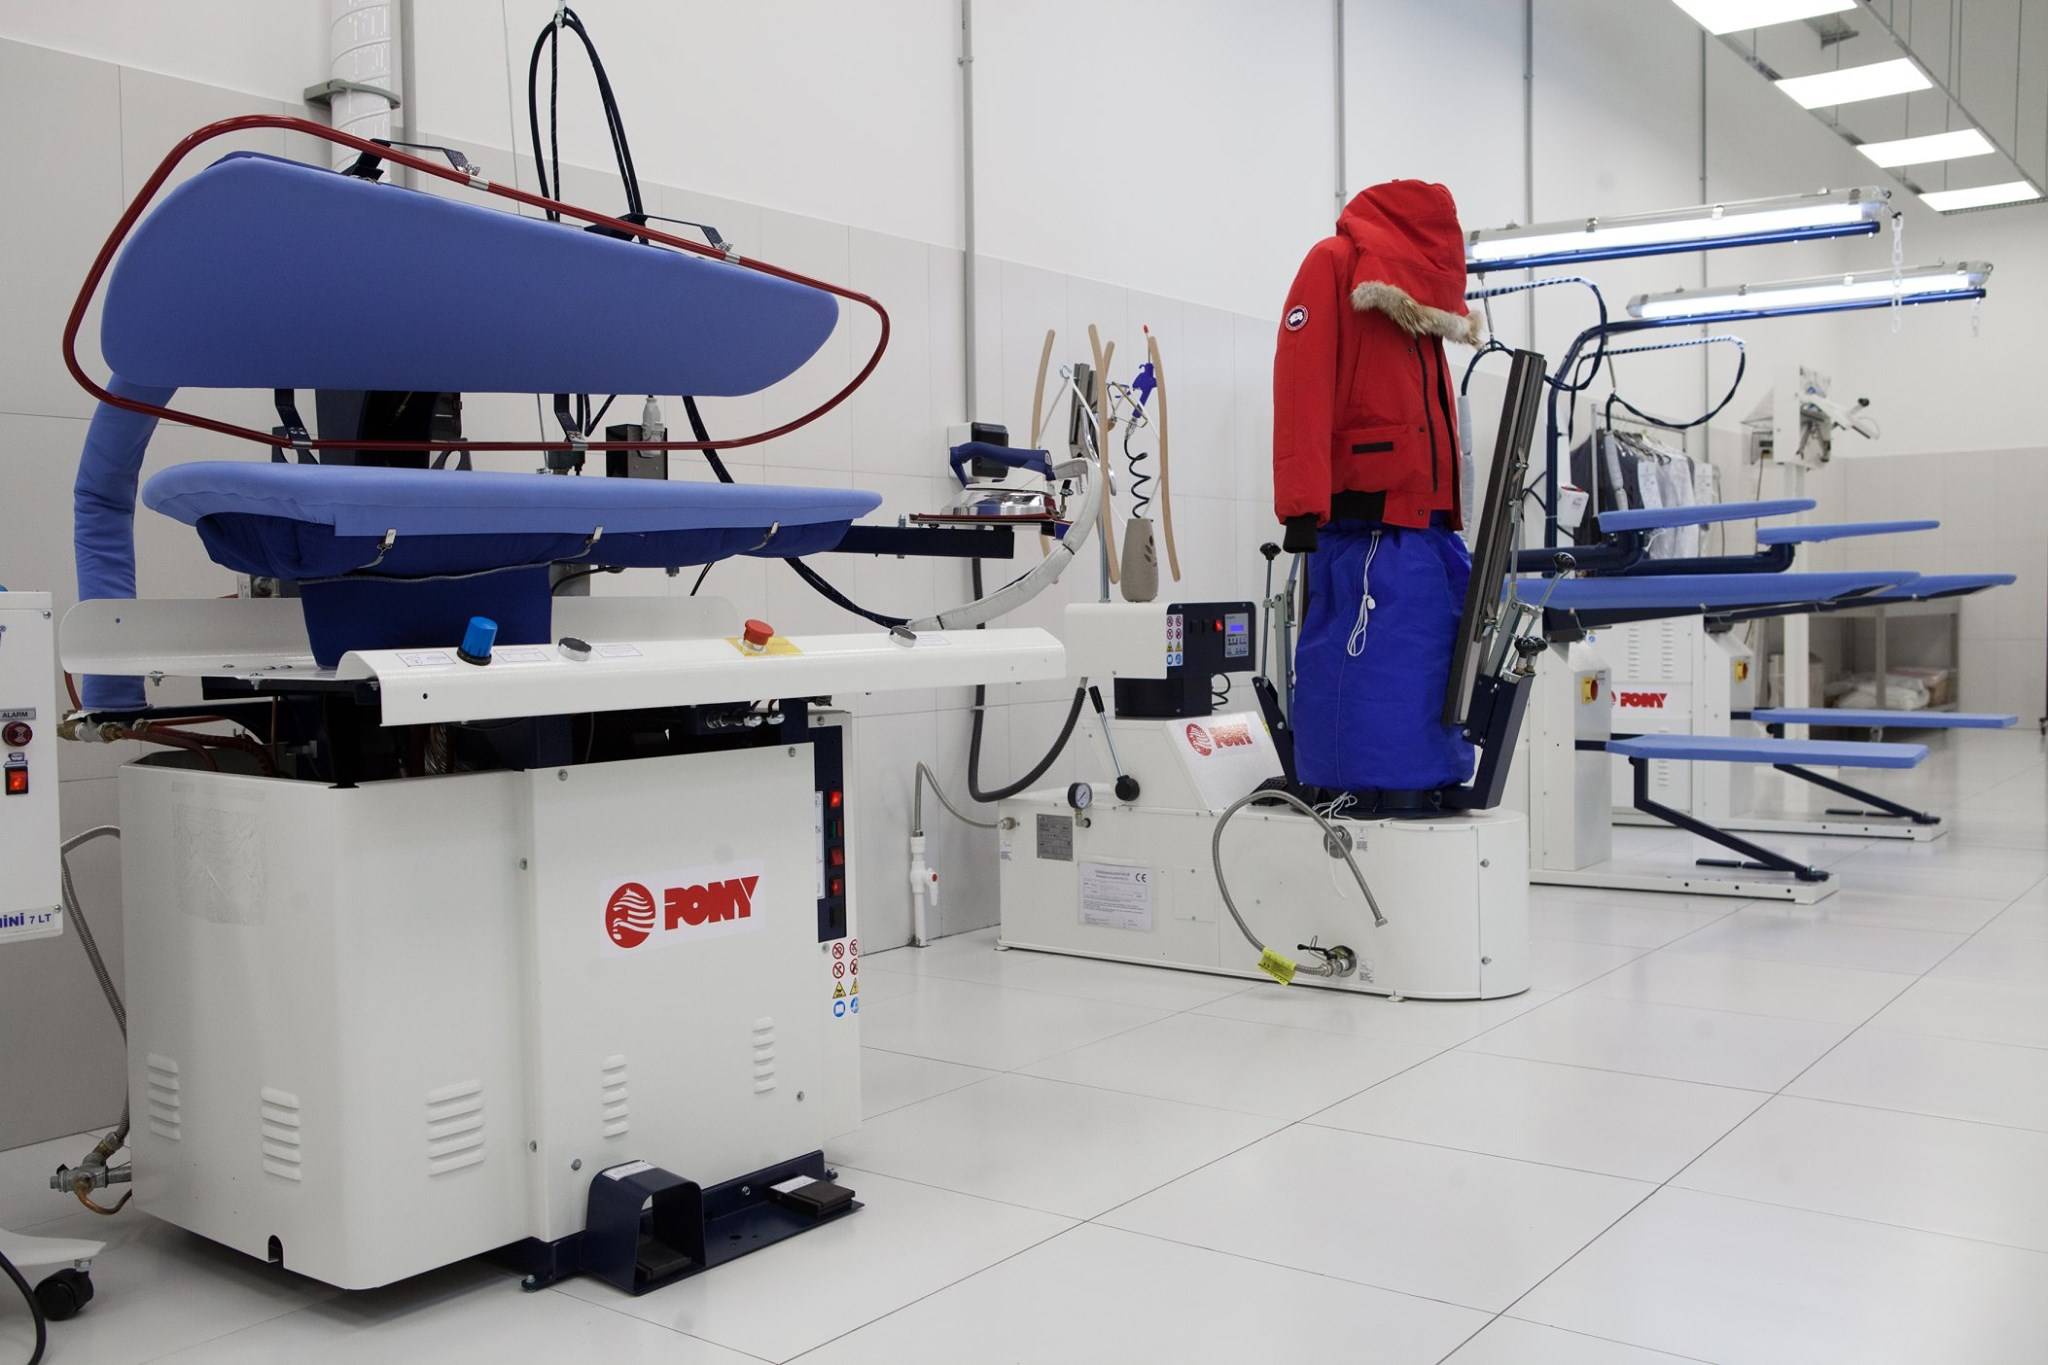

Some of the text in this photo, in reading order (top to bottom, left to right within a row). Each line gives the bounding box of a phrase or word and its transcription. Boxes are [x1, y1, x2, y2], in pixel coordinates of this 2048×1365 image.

[1620, 692, 1668, 709] PONY
[2, 711, 28, 719] ALARM
[1135, 872, 1147, 883] CE
[664, 875, 760, 931] PONY
[29, 915, 35, 925] 7
[38, 913, 52, 923] LT
